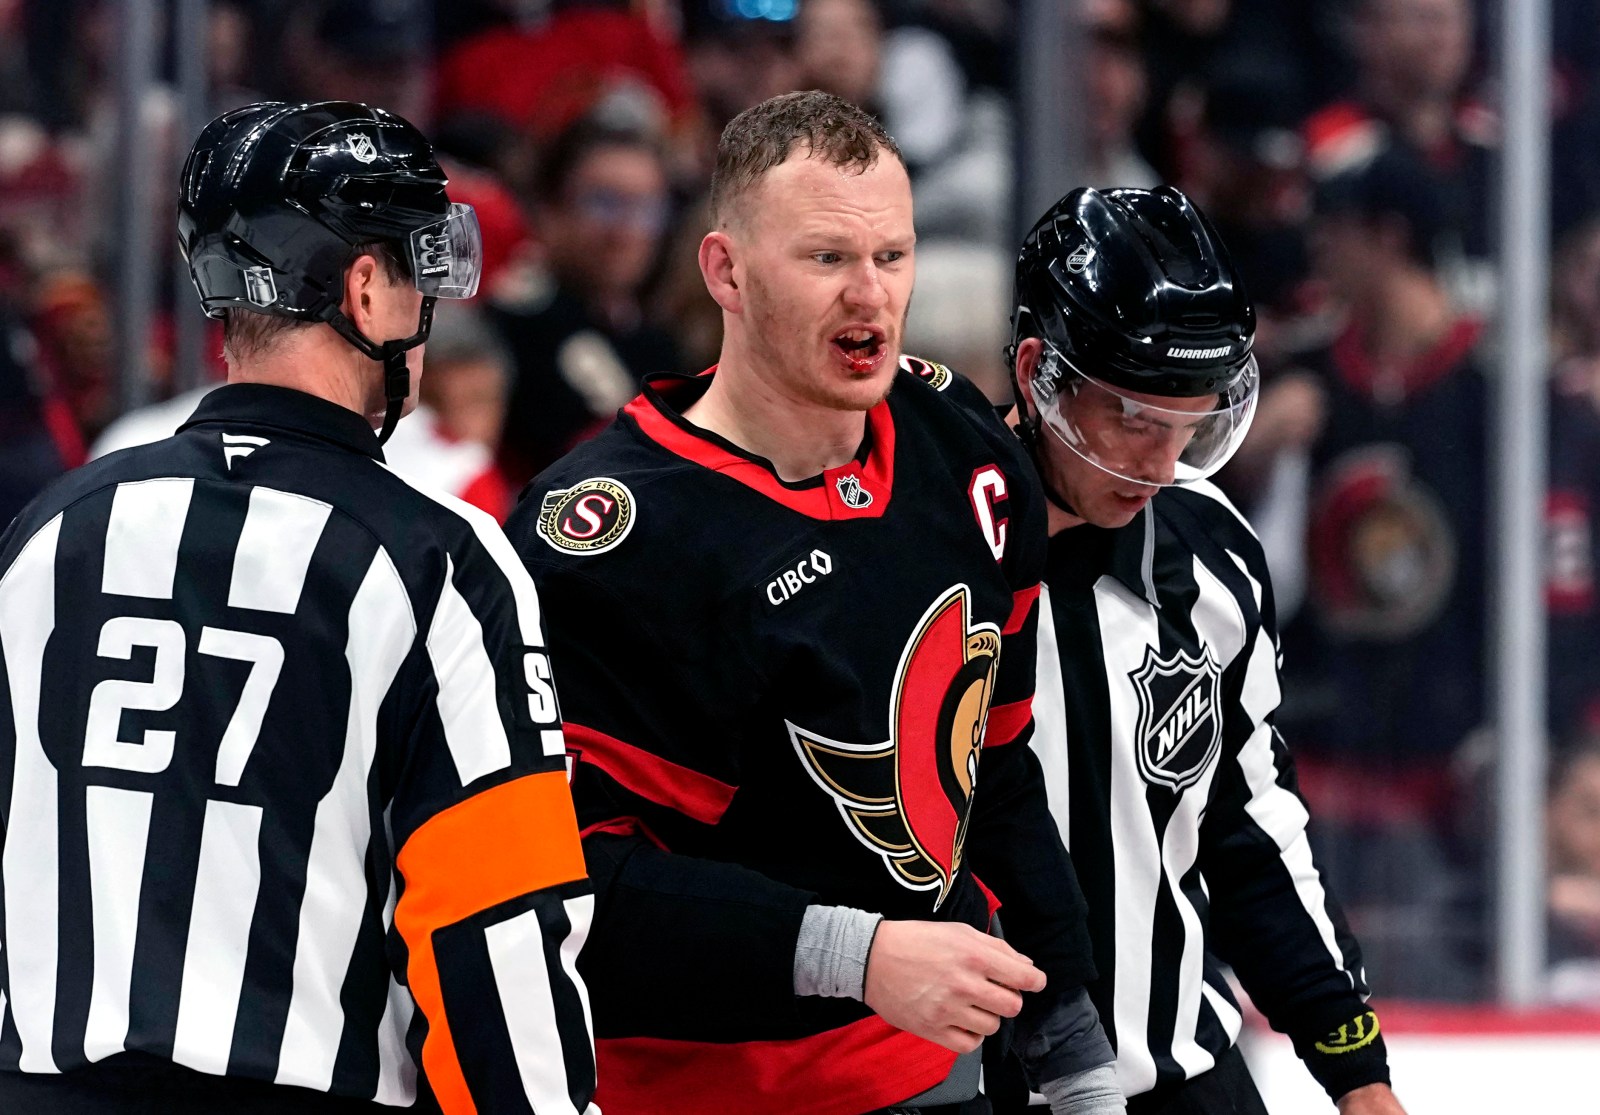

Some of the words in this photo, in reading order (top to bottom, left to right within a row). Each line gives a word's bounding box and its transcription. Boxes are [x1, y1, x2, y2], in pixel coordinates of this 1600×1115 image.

[422, 265, 449, 275] BAUER
[1166, 345, 1232, 360] WARRIOR
[596, 482, 615, 493] EST.
[848, 485, 858, 505] NHL
[562, 494, 614, 538] S
[967, 463, 1008, 564] C
[766, 560, 817, 606] CIBC
[81, 616, 286, 787] 27
[523, 652, 563, 725] S
[1156, 685, 1209, 762] NHL
